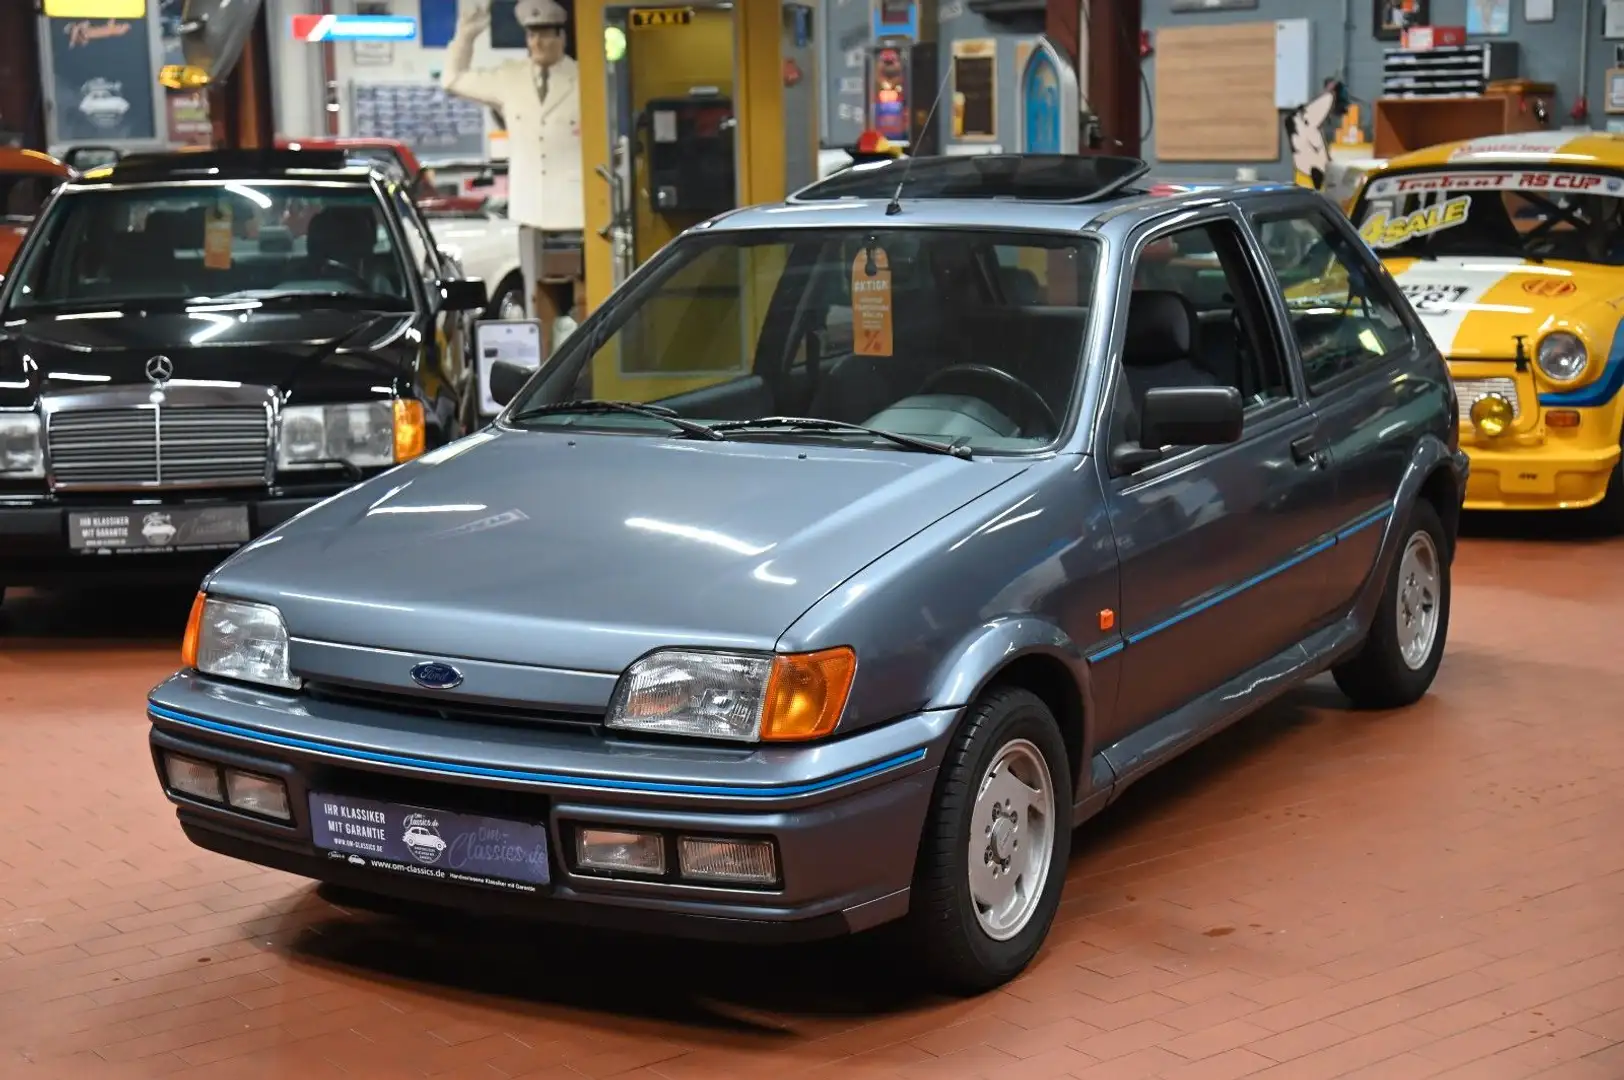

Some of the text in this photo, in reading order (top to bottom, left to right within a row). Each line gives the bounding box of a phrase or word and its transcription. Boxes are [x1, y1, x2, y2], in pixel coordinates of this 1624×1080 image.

[639, 12, 683, 25] TAXI
[1519, 173, 1551, 187] RS
[1553, 175, 1602, 189] CUP
[420, 665, 450, 681] Ford
[324, 803, 386, 825] IHR KLASSIKER
[328, 820, 386, 841] MIT GARANTIE
[371, 860, 446, 879] www.om-classics.de
